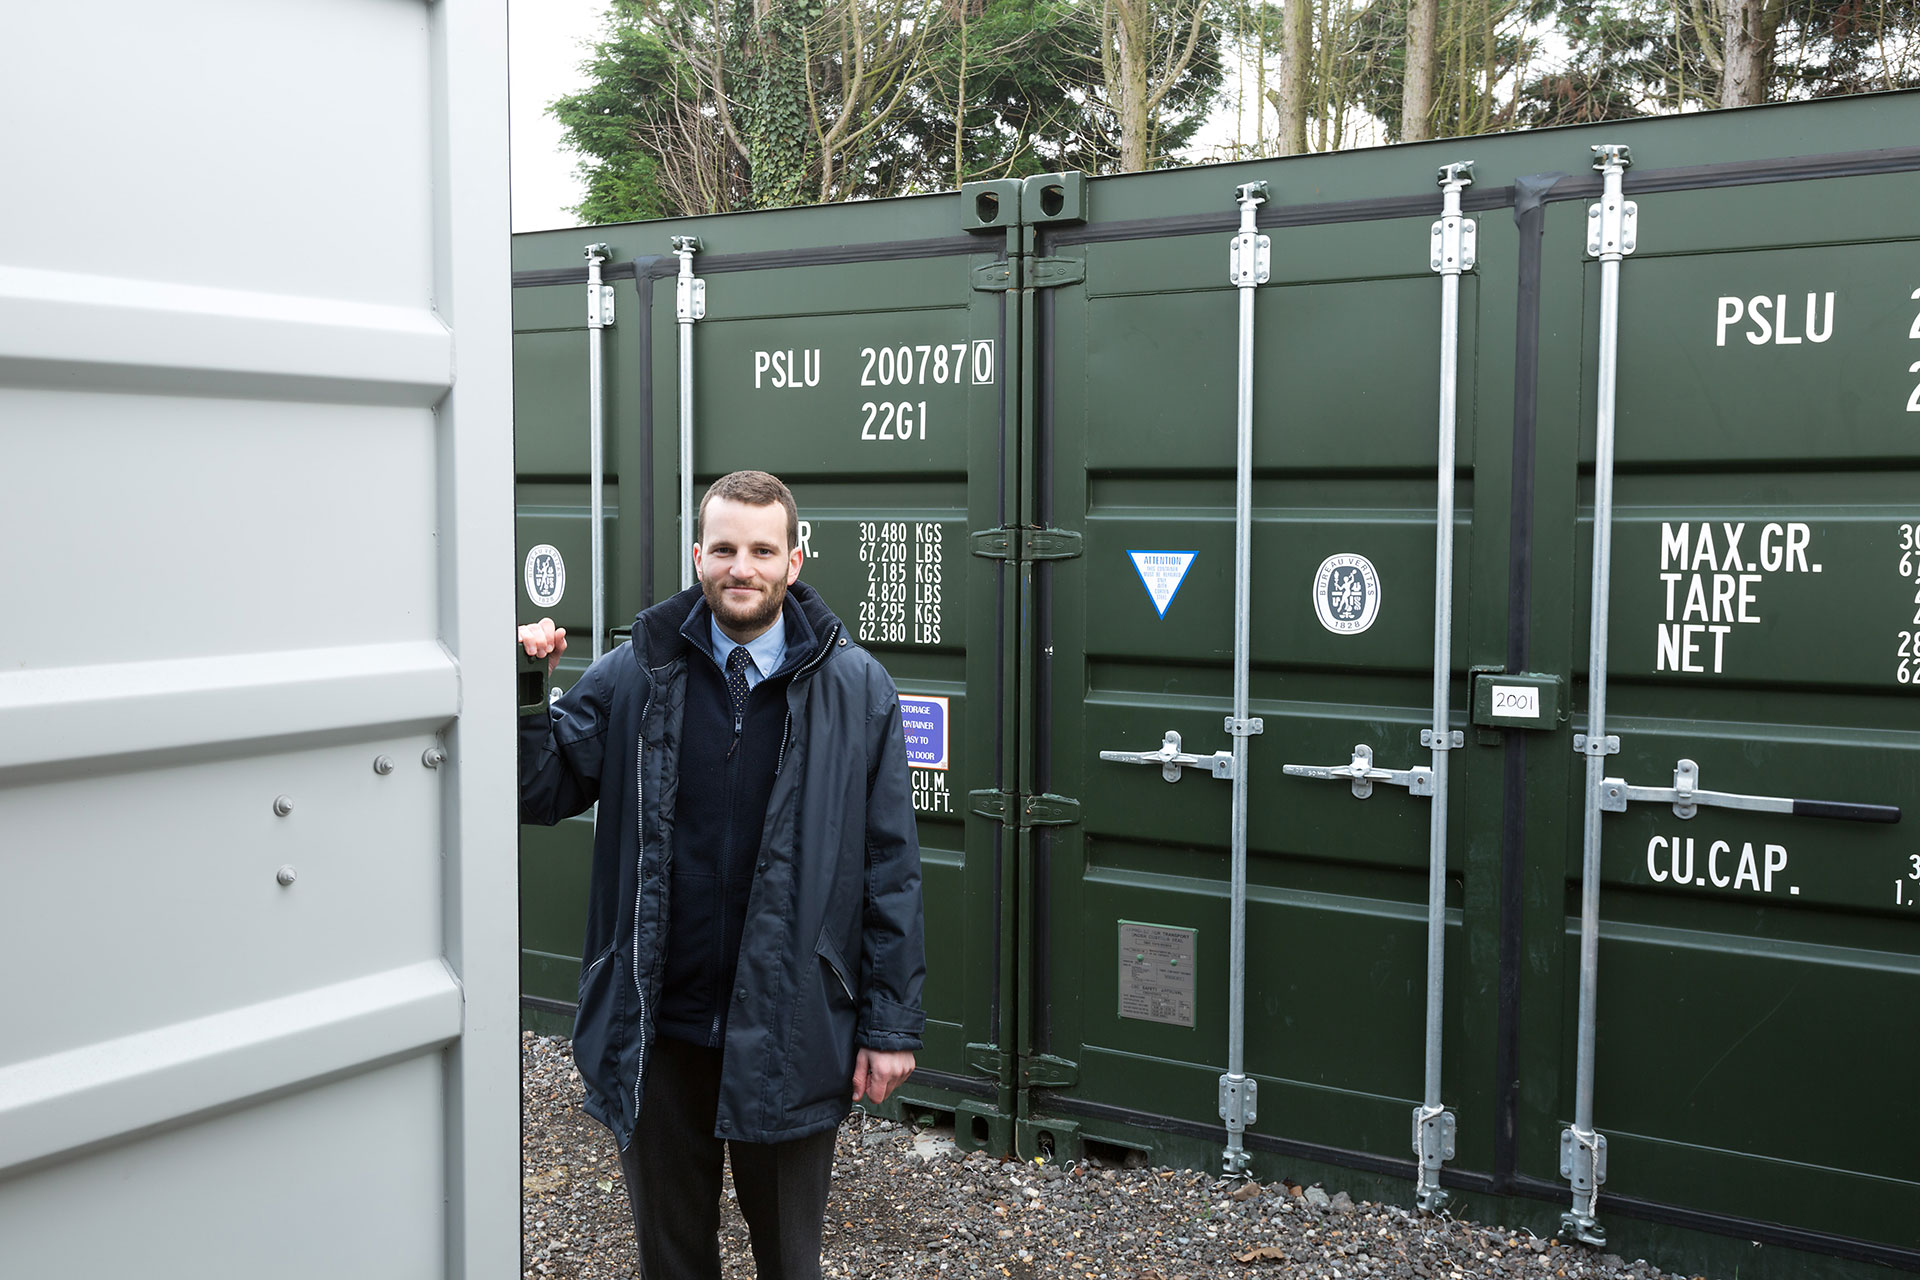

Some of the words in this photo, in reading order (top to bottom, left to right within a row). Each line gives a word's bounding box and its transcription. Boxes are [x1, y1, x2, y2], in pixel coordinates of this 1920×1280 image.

[1717, 292, 1835, 347] PSLU
[755, 349, 820, 389] PSLU
[861, 401, 927, 440] 22G1
[859, 523, 907, 543] 30,480
[915, 523, 942, 543] KGS
[859, 542, 907, 562] 67,200
[915, 543, 942, 563] LBS
[1660, 522, 1823, 573] MAX.GR.
[1144, 556, 1182, 565] ATTENTION
[867, 562, 907, 582] 2,185
[915, 563, 942, 583] KGS
[1319, 558, 1344, 596] BUREAU
[1348, 558, 1375, 596] VERITAS
[867, 582, 907, 602] 4,820
[915, 584, 942, 604] LBS
[1660, 573, 1762, 623] TARE
[859, 602, 906, 622] 28,295
[914, 603, 942, 624] KGS
[859, 622, 906, 641] 62,380
[914, 623, 941, 644] LBS
[1334, 620, 1361, 629] 1828
[1656, 623, 1731, 674] NET
[901, 704, 931, 715] STORAGE
[1496, 692, 1533, 710] 2001
[902, 719, 934, 730] ONTAINER
[920, 736, 929, 745] TO
[915, 751, 935, 761] DOOR
[911, 770, 949, 792] CU.M.
[911, 790, 954, 813] CU.FT.
[1646, 835, 1800, 895] CU.CAP.
